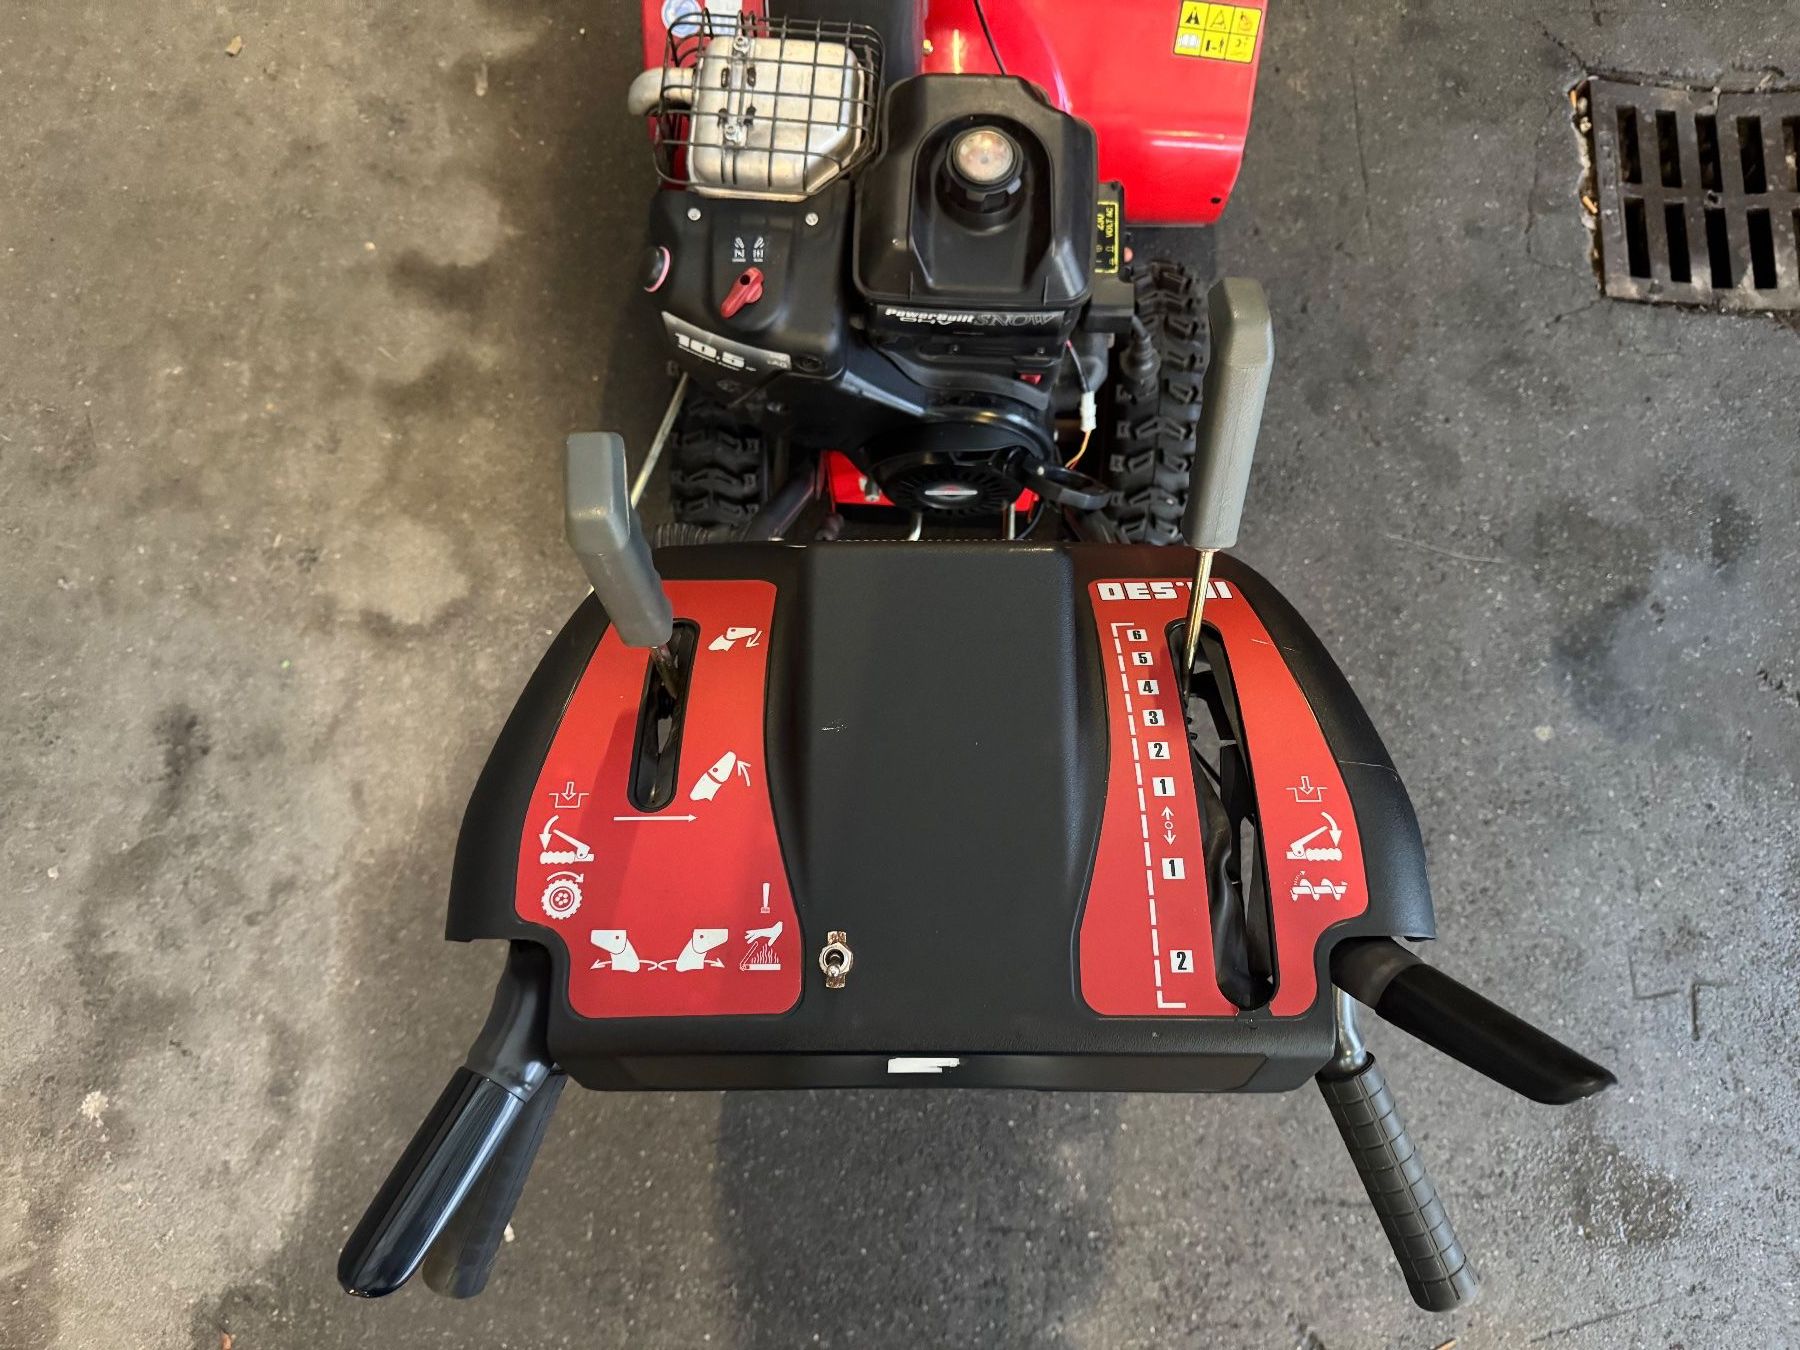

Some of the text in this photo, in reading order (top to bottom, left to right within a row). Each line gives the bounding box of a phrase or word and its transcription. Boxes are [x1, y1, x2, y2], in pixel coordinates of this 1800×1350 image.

[1105, 207, 1114, 238] VOLT AC
[675, 332, 745, 368] 10.5
[1132, 630, 1142, 640] 6
[1138, 652, 1148, 664] 5
[1142, 680, 1154, 694] 4
[1148, 710, 1158, 725] 3
[1153, 742, 1164, 758] 2
[1159, 778, 1168, 795] 1
[1168, 859, 1176, 877] 1
[1176, 951, 1187, 971] 2
